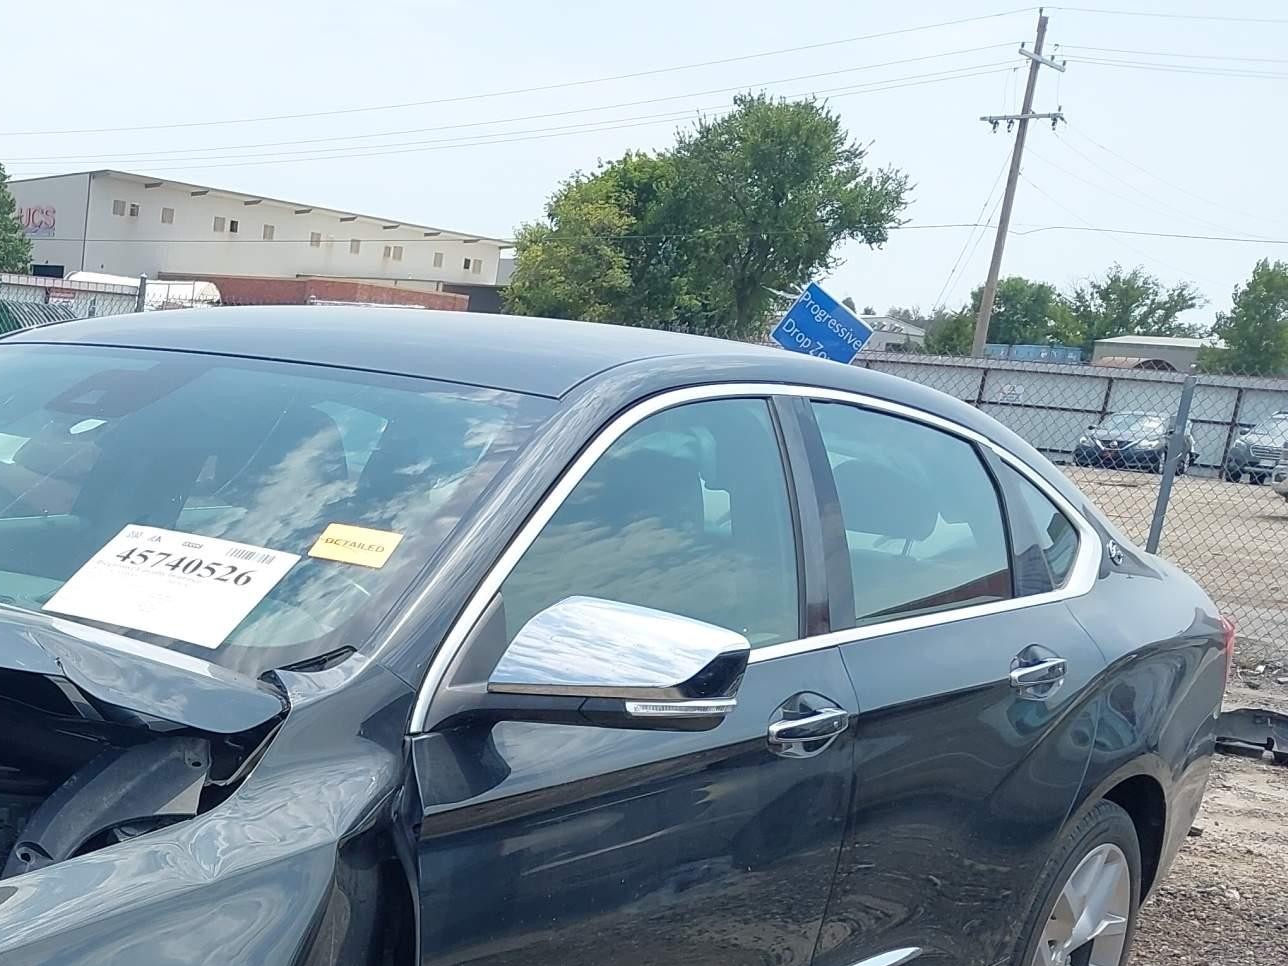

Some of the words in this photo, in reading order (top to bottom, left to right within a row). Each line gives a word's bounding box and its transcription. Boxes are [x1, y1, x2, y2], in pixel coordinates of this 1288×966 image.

[782, 318, 812, 348] Drop
[809, 341, 831, 360] Zo
[799, 291, 863, 350] Progressive
[115, 547, 257, 586] 45740526
